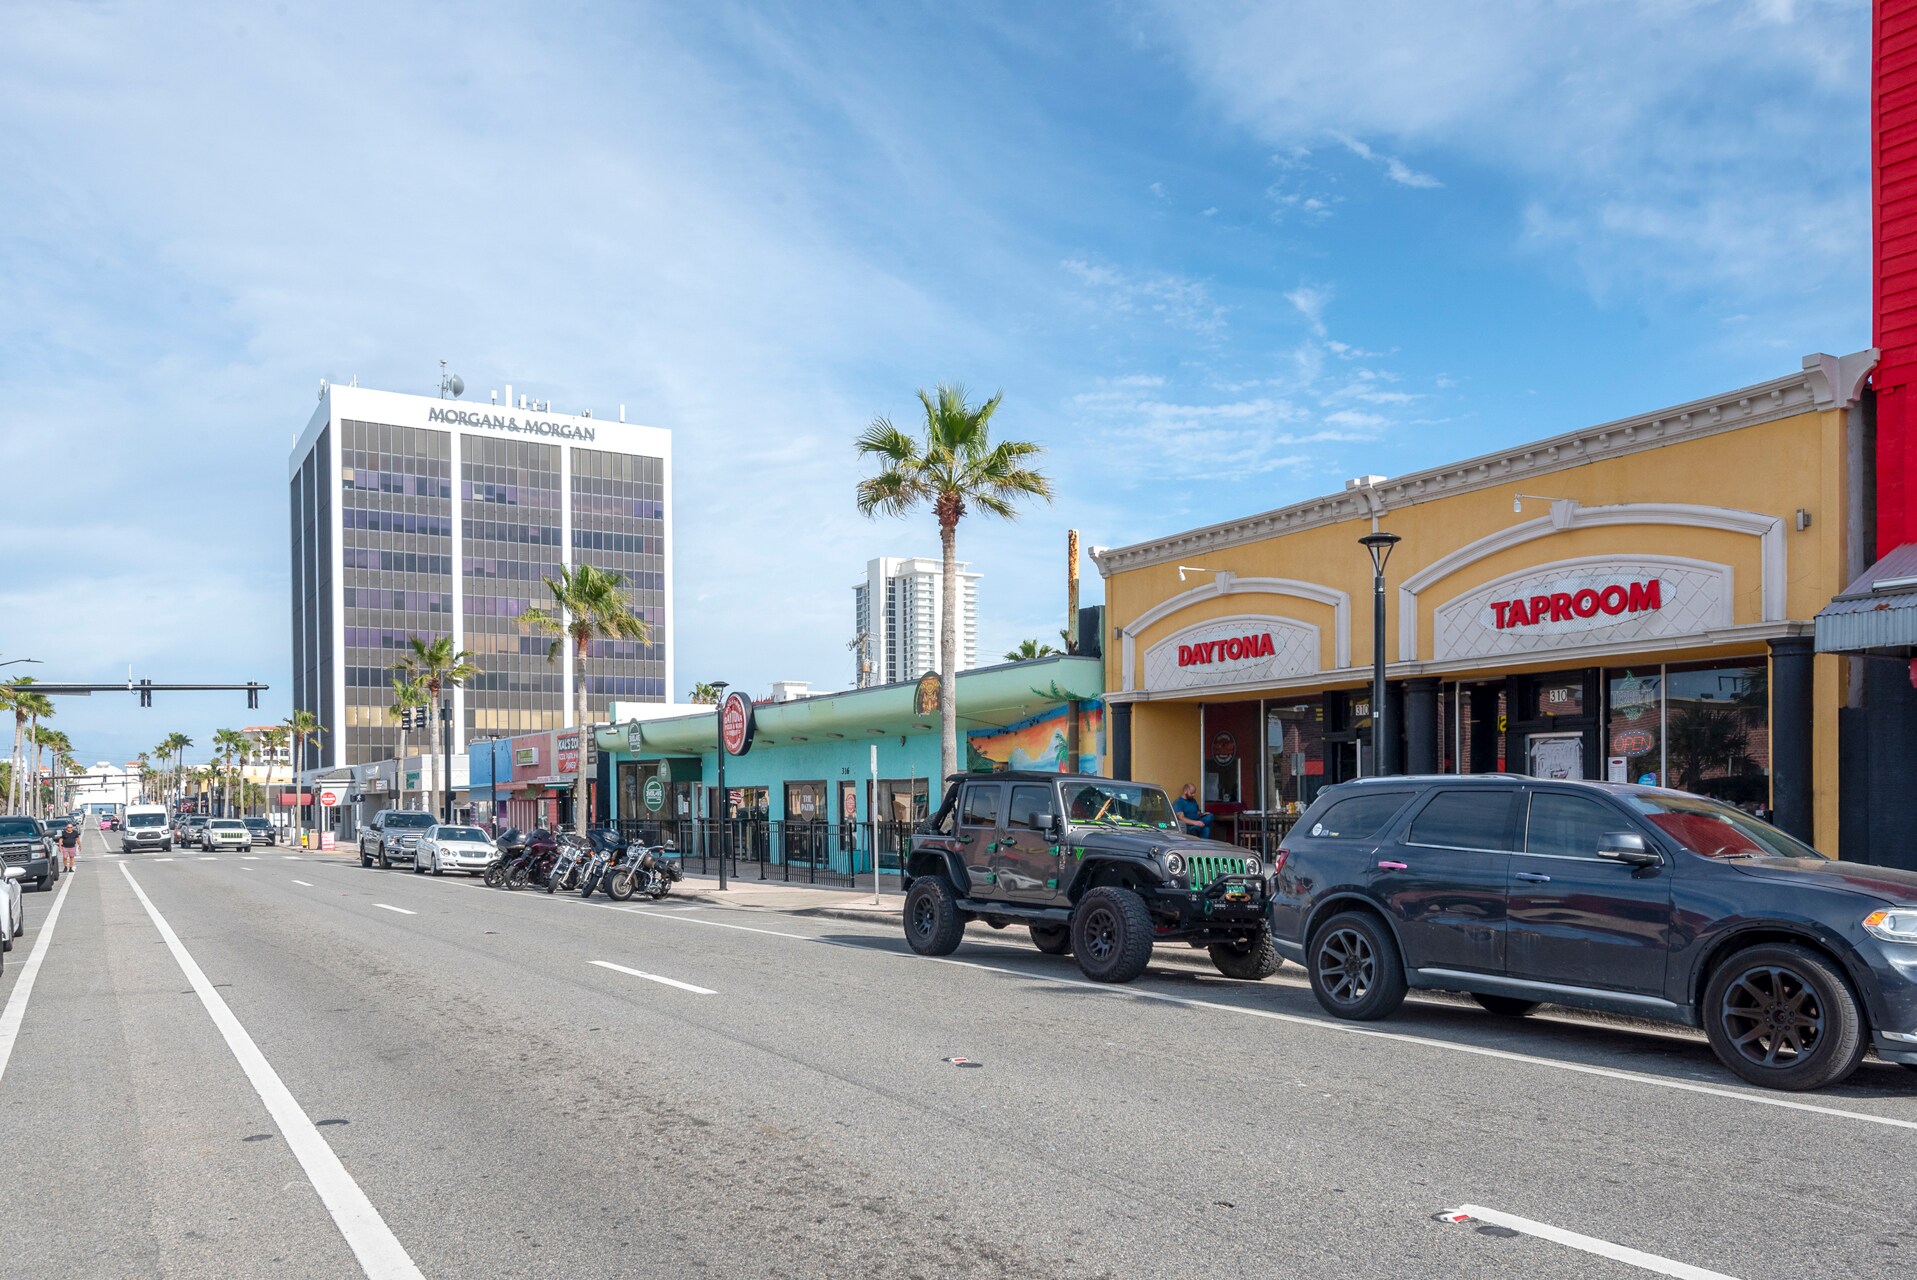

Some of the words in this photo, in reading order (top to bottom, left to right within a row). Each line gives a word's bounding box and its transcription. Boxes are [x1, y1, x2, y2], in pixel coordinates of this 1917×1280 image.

[428, 407, 504, 430] MORGAN
[509, 417, 520, 433] &
[524, 419, 595, 441] MORGAN
[1490, 579, 1661, 630] TAPROOM
[1178, 633, 1275, 667] DAYTONA
[1551, 690, 1567, 702] 310
[1357, 705, 1369, 715] 310
[1614, 736, 1652, 751] OPEN
[841, 767, 850, 775] 316
